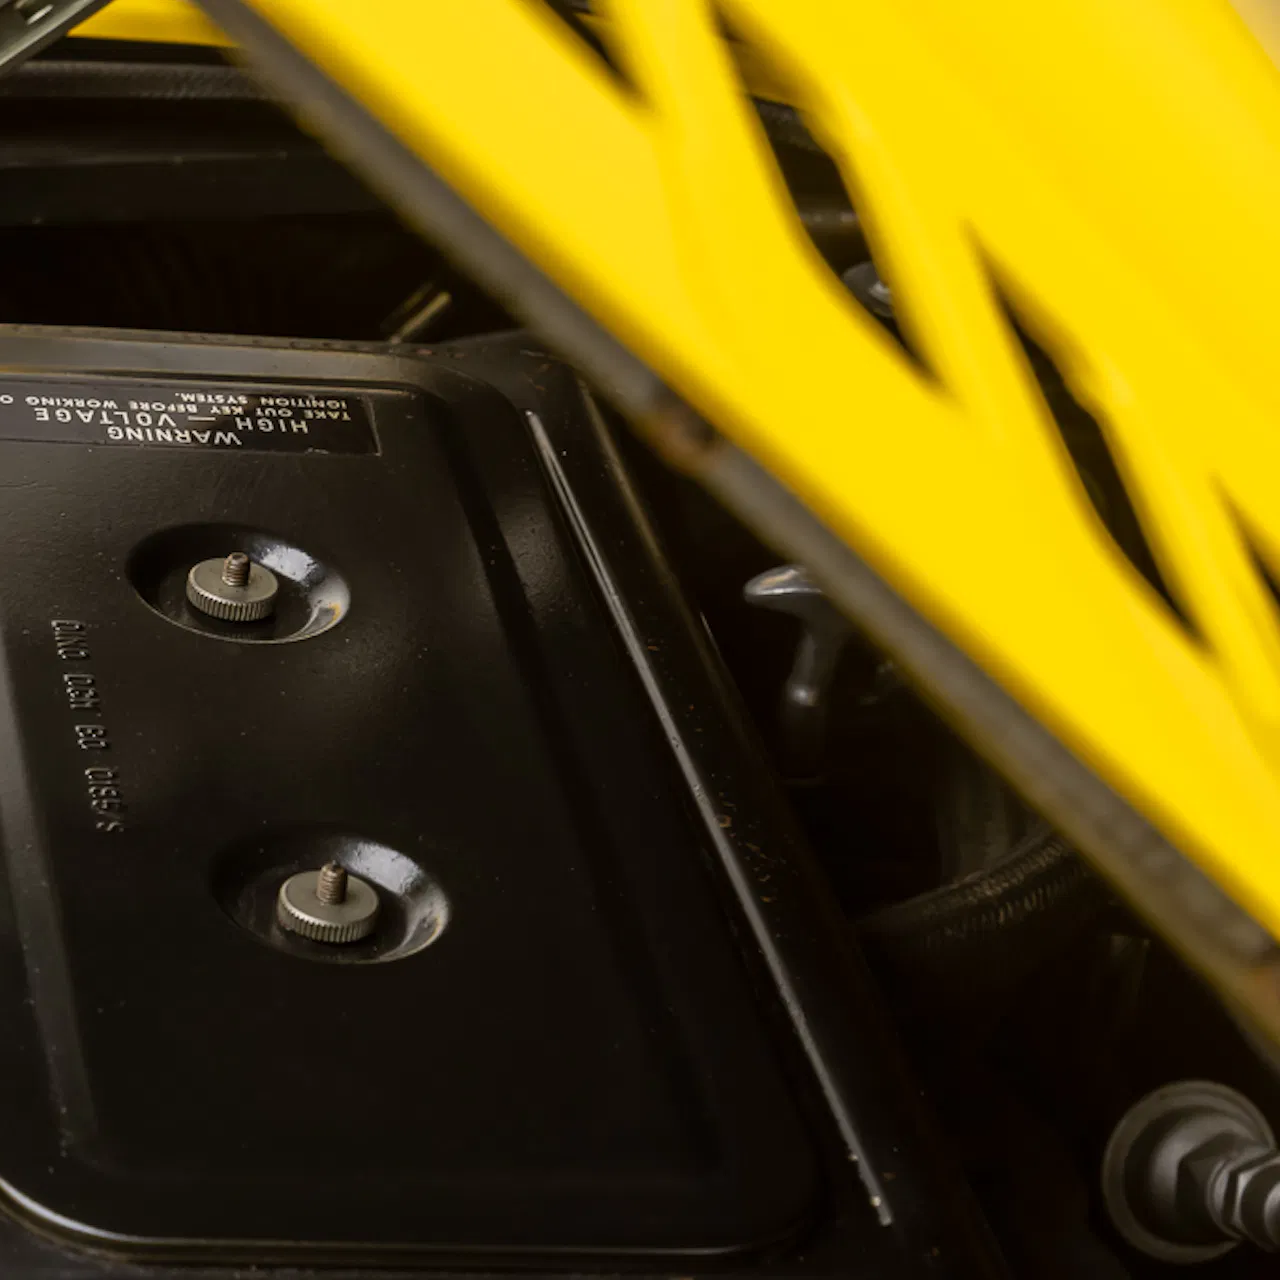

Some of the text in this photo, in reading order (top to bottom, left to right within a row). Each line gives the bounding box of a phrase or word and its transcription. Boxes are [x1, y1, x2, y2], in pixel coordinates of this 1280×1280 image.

[26, 396, 116, 409] WORKING
[175, 392, 346, 409] IGNITION SYSTEM.
[130, 401, 197, 413] BEFORE
[211, 405, 243, 415] KEY
[256, 407, 292, 417] OUT
[33, 407, 307, 433] HIGH VOLTAGE
[304, 409, 350, 421] TAKE
[107, 426, 241, 445] WARNING
